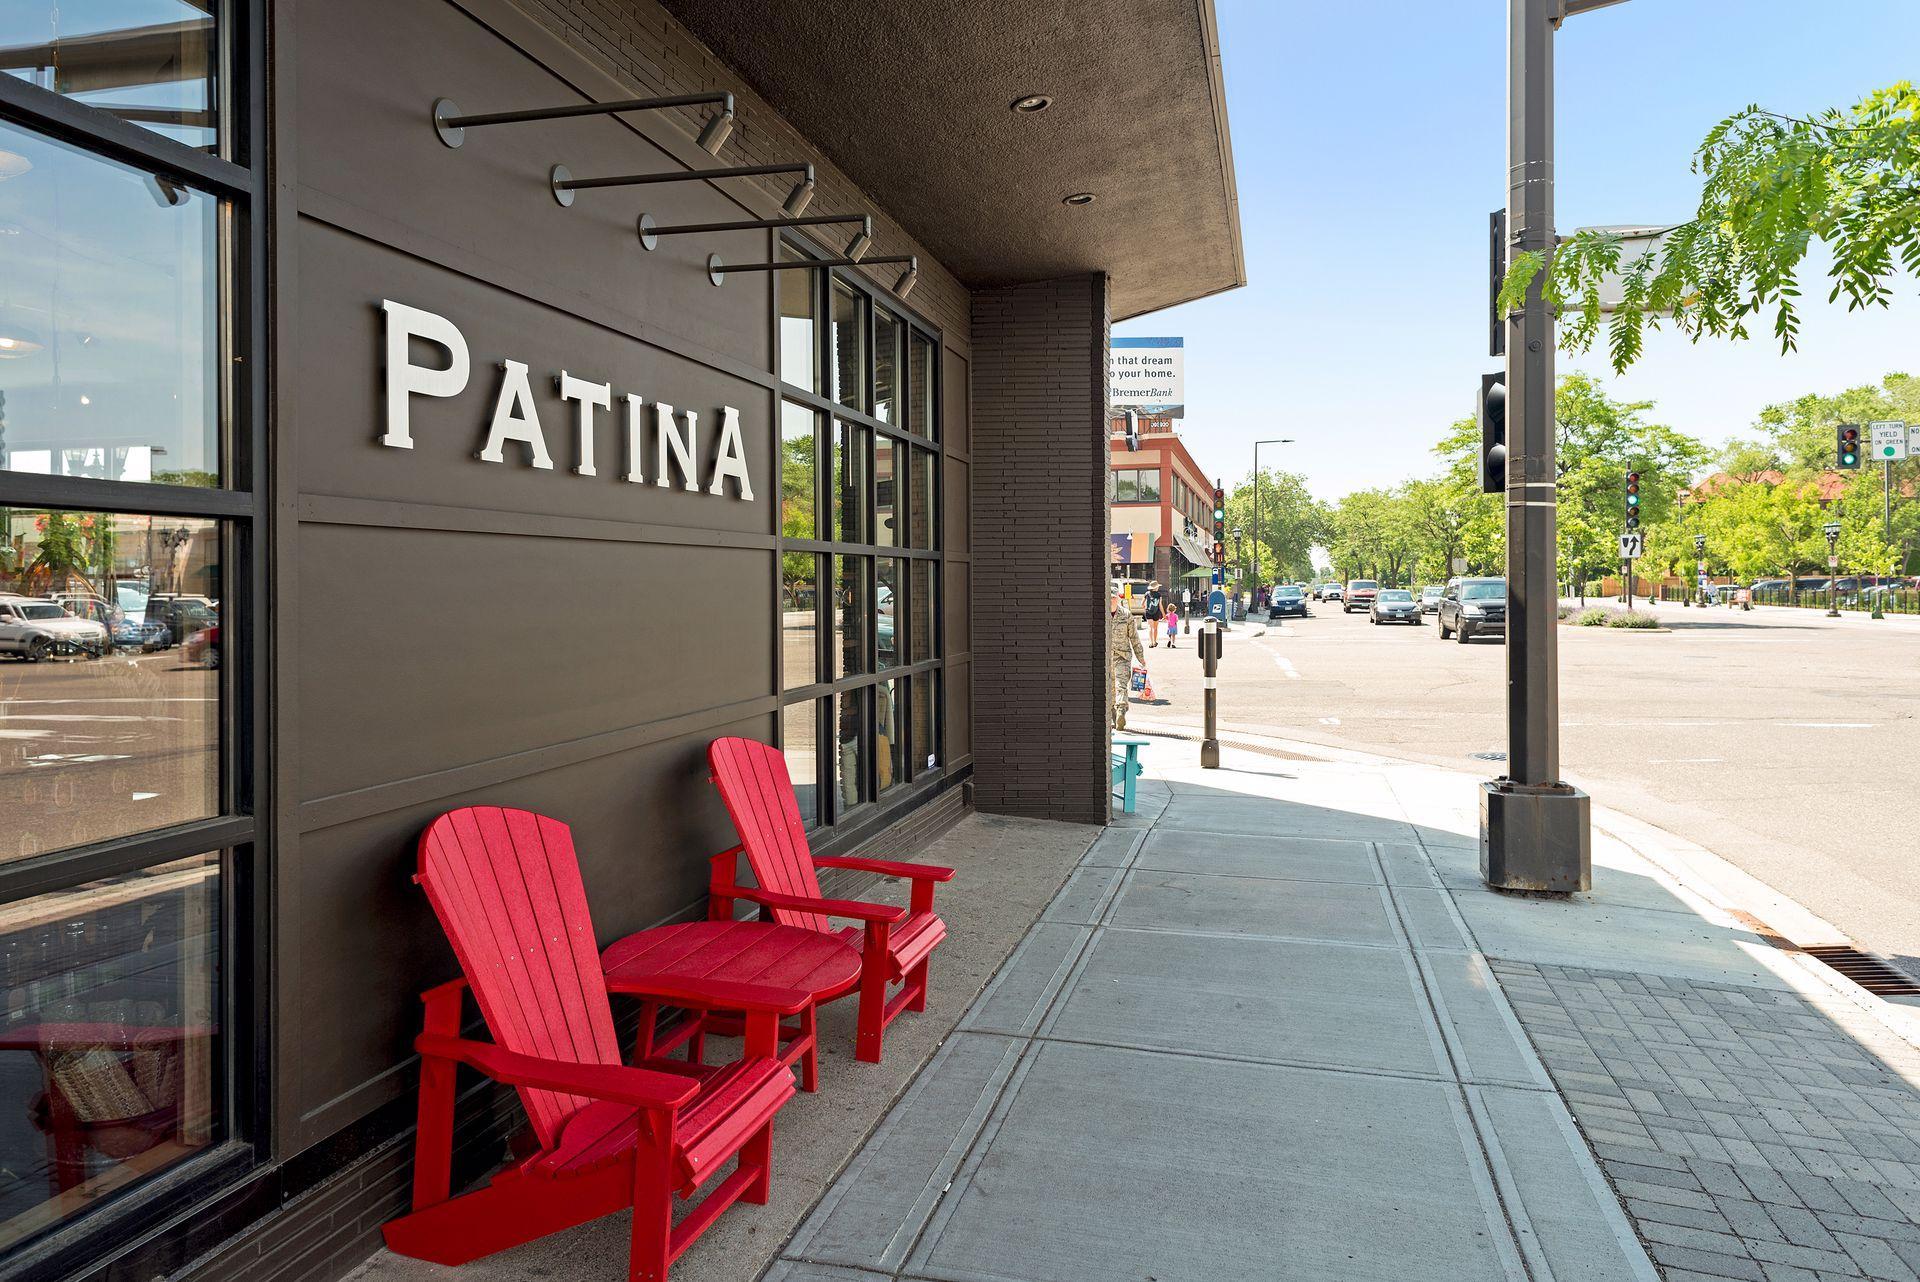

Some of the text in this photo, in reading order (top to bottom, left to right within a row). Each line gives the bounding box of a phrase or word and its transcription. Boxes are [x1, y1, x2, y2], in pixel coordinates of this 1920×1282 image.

[1117, 356, 1138, 365] that
[1141, 356, 1172, 365] dream
[1118, 370, 1141, 380] your
[1144, 368, 1176, 378] home.
[1112, 387, 1173, 397] BremerBank
[383, 298, 754, 501] PATINA
